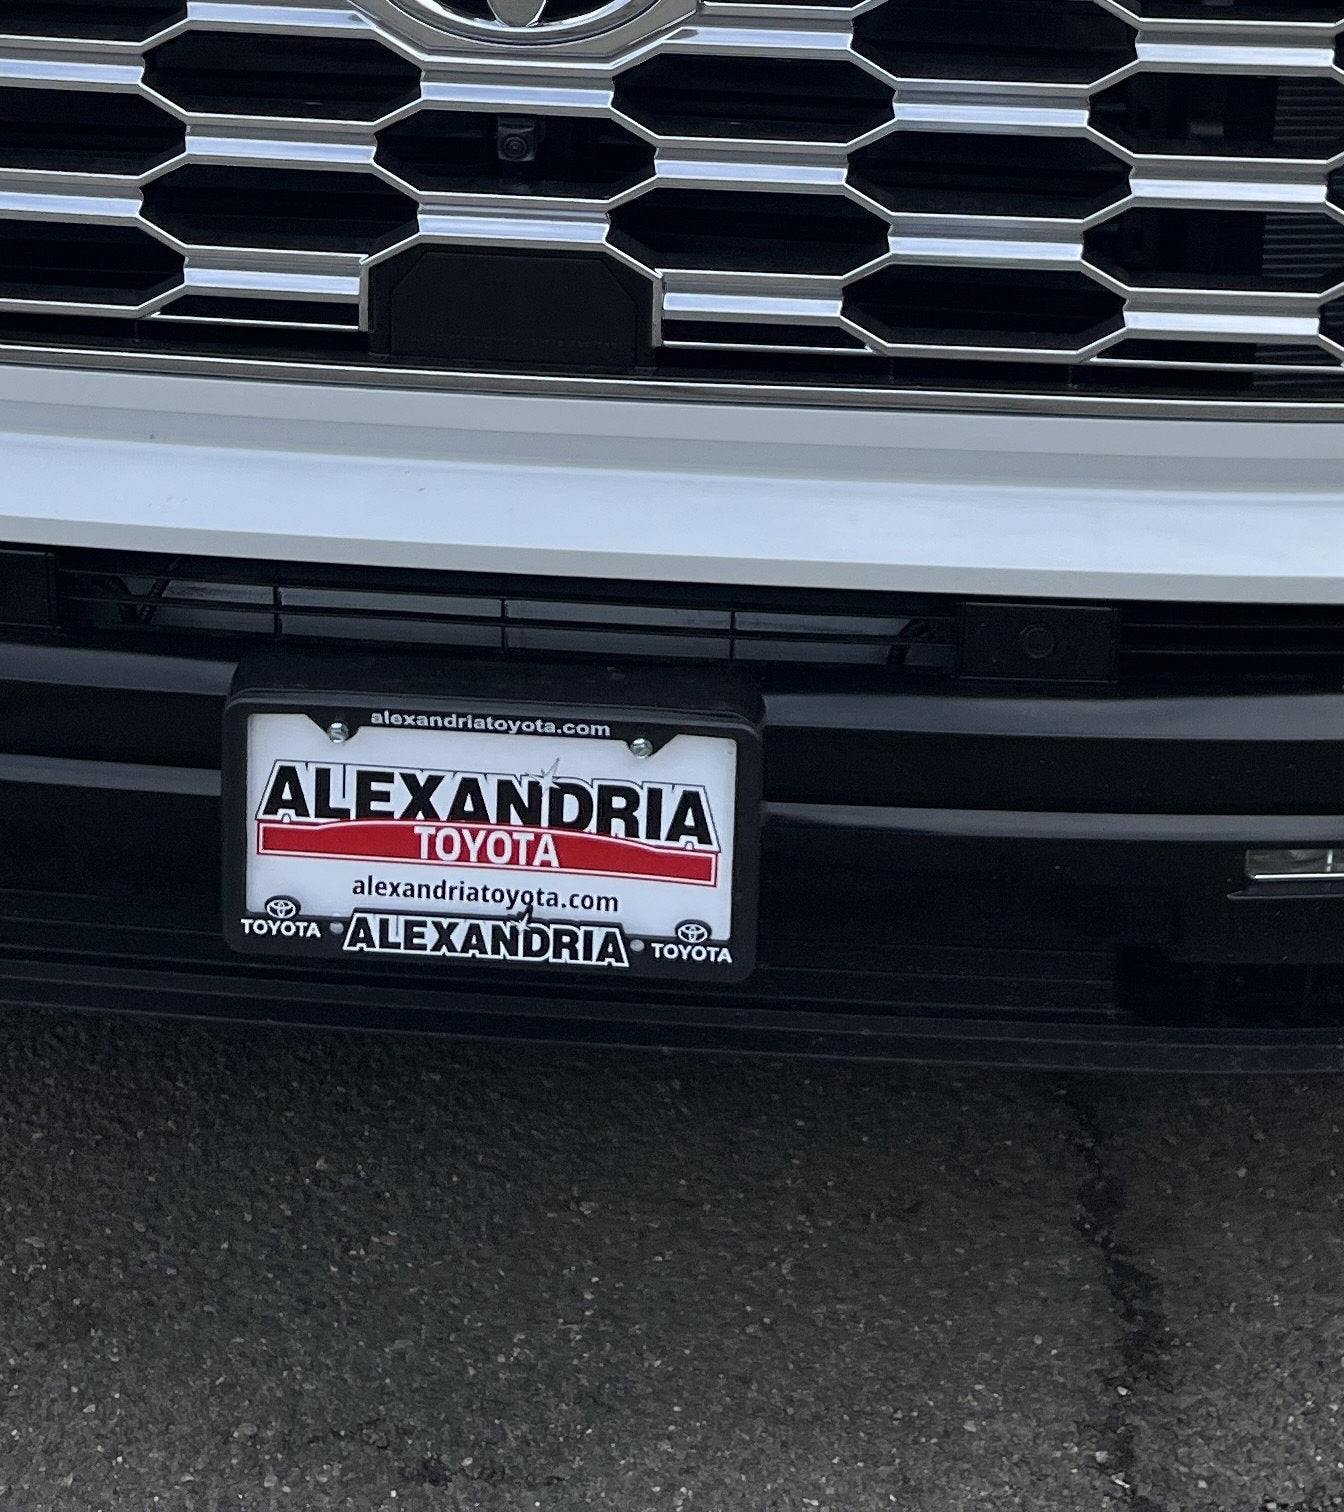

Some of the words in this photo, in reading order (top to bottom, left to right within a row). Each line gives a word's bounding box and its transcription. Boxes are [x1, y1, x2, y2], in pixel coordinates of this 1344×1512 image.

[369, 709, 611, 738] alexandriatoyota.com
[259, 762, 716, 848] ALEXANDRIA
[413, 824, 560, 868] TOYOTA
[351, 874, 619, 913] alexandriatoyota.com
[240, 917, 322, 940] TOYOTA
[344, 914, 629, 967] ALEXANDRIA
[651, 941, 733, 965] TOYOTA
